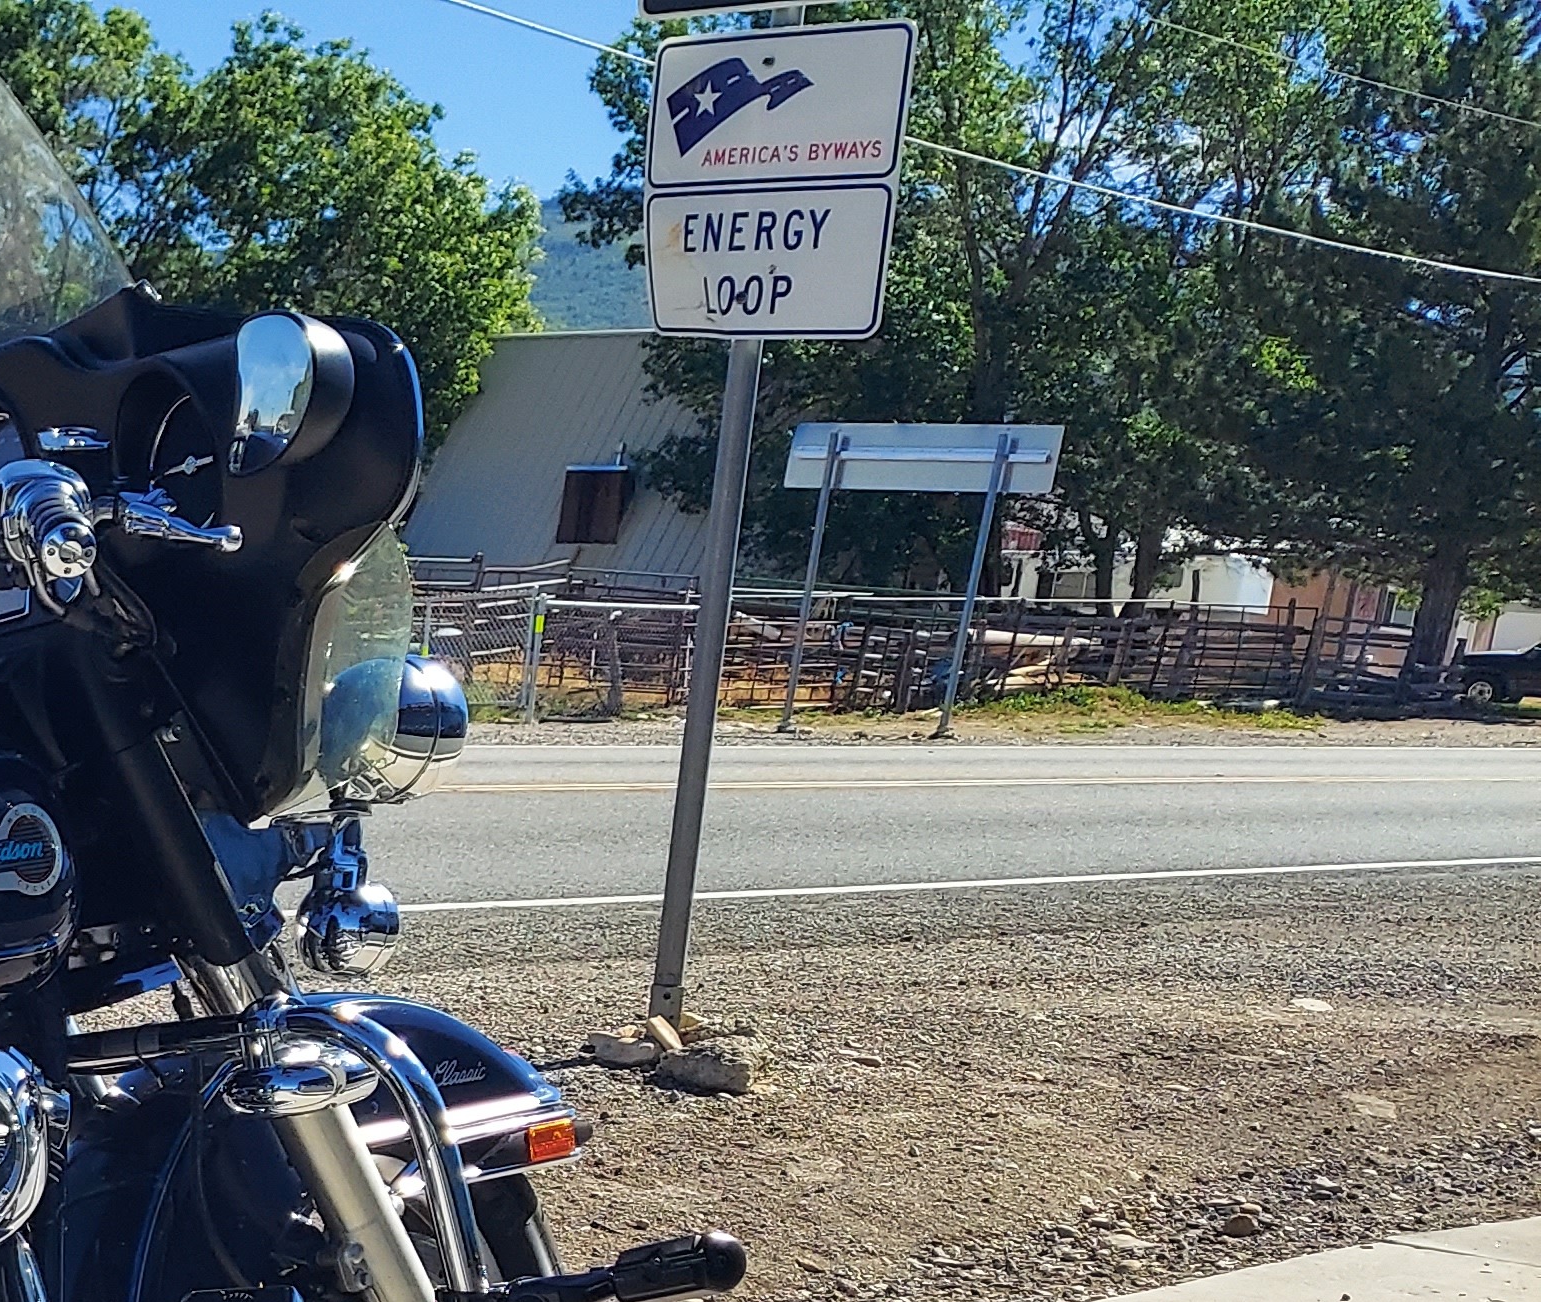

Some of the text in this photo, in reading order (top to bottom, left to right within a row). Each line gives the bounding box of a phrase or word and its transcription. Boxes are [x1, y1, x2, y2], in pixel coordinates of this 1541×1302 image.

[701, 140, 883, 167] AMERICA'S BYWAYS
[683, 208, 831, 254] ENERGY
[703, 274, 793, 316] LOOP
